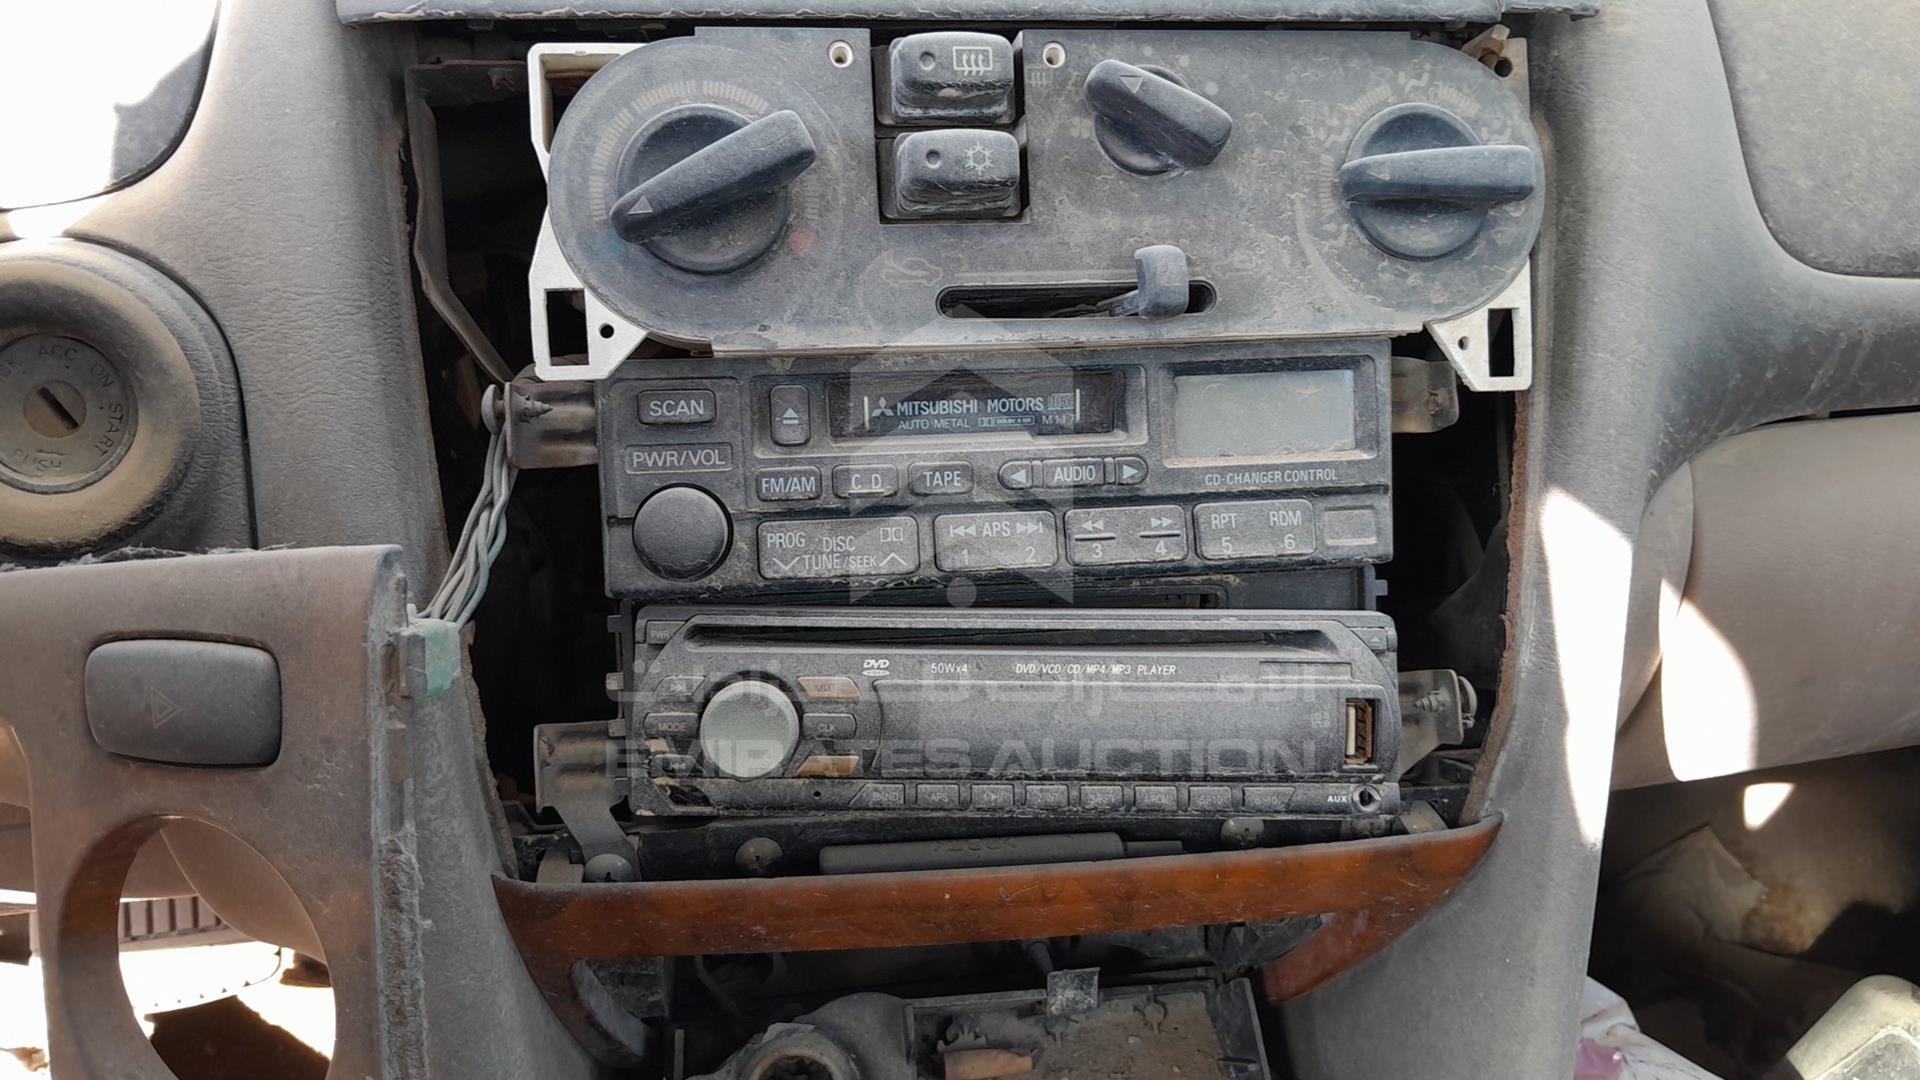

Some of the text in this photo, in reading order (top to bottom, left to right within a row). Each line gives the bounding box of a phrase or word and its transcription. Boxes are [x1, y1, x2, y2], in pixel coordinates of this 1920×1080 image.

[38, 344, 78, 361] ACC
[90, 363, 115, 388] ON
[649, 399, 705, 417] SCAN
[896, 396, 1044, 416] MITSUBISHI MOTORS
[94, 402, 126, 457] START
[898, 418, 970, 430] AUTO METAL
[632, 451, 726, 468] PWR/VOL
[923, 470, 962, 487] TAPE
[1054, 465, 1096, 482] AUDIO
[1204, 468, 1338, 486] CD-CHANGER CONTROL
[761, 477, 816, 494] FM/AM
[1210, 513, 1237, 529] RPT
[1269, 510, 1302, 527] RDM
[982, 521, 1011, 538] APS
[767, 532, 805, 549] PROG
[822, 535, 856, 552] DISC
[1154, 539, 1167, 555] 4
[1220, 537, 1233, 553] 5
[1284, 533, 1296, 551] 6
[961, 549, 970, 566] 1
[1025, 546, 1036, 562] 2
[1091, 543, 1103, 558] 3
[803, 554, 878, 571] TUNE/SEEK
[650, 630, 669, 640] PWR
[863, 659, 890, 669] DVD
[931, 662, 968, 675] 50Wx4
[1015, 662, 1177, 676] DVD/VCD/CD/MP4/MP3 PLAYER
[657, 722, 687, 732] MODE
[817, 723, 836, 733] CLK
[872, 791, 899, 802] BAND
[930, 792, 949, 802] APS
[1327, 795, 1348, 804] AUX
